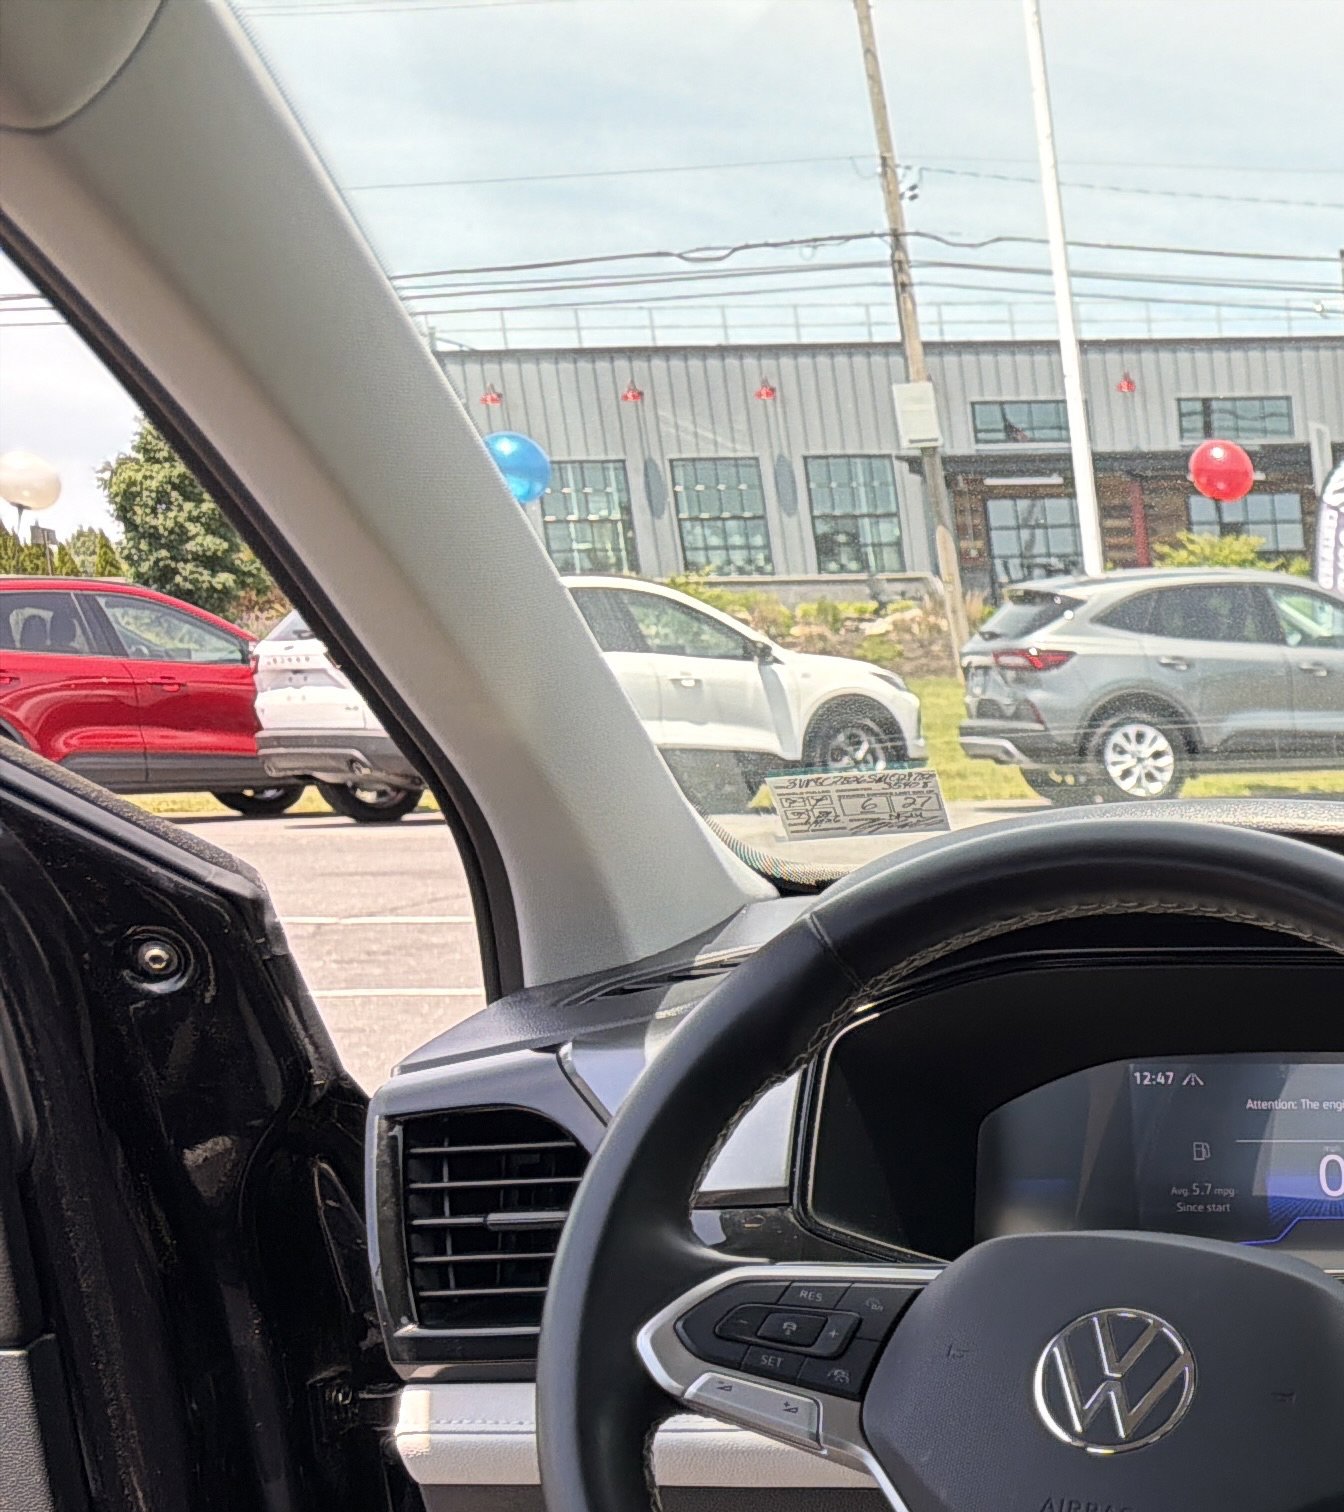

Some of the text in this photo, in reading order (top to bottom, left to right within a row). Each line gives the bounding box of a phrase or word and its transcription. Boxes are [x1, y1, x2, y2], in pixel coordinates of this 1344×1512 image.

[861, 797, 878, 811] 6
[901, 796, 933, 809] 27
[1133, 1071, 1174, 1086] 12:47
[1246, 1098, 1298, 1110] Attention:
[1301, 1098, 1320, 1110] The
[1191, 1182, 1212, 1196] 5.7
[1176, 1201, 1231, 1213] Since start
[799, 1288, 823, 1302] RES
[760, 1353, 784, 1369] SET
